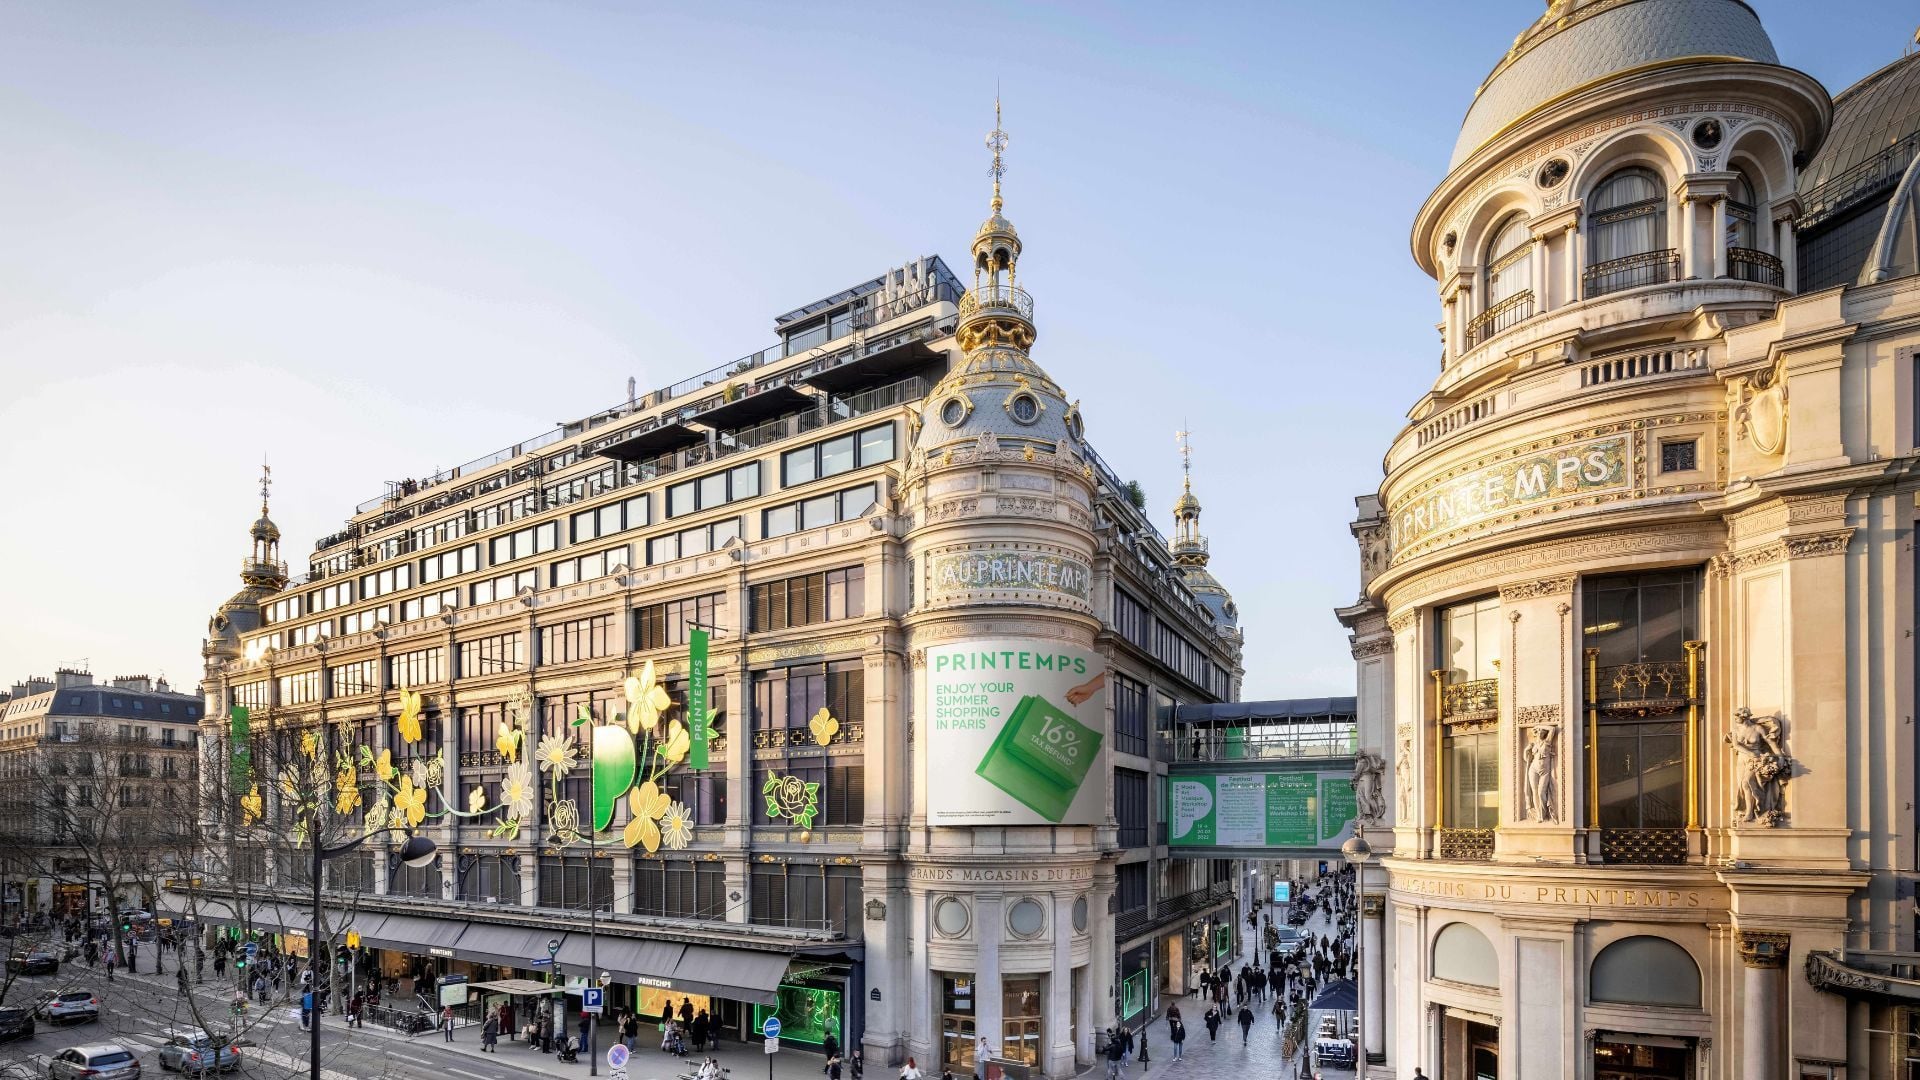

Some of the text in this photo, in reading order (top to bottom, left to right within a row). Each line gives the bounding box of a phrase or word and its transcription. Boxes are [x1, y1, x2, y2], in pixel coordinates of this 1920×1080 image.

[1402, 451, 1608, 543] PRINTEMPS
[943, 559, 1089, 593] AU PRINTEMPS
[936, 651, 1086, 674] PRINTEMPS
[936, 682, 1014, 695] ENJOY YOUR
[694, 660, 703, 740] PRINTEMPS
[936, 695, 988, 706] SUMMER
[936, 706, 1000, 718] SHOPPING
[936, 718, 986, 730] IN PARIS
[1031, 734, 1043, 748] TAX
[1040, 715, 1081, 758] 16%
[910, 868, 953, 880] GRANDS
[963, 869, 1039, 881] MAGASINS
[1048, 869, 1063, 881] DU
[1485, 885, 1512, 899] DU
[1537, 887, 1699, 906] PRINTEMPS
[587, 990, 598, 1005] P
